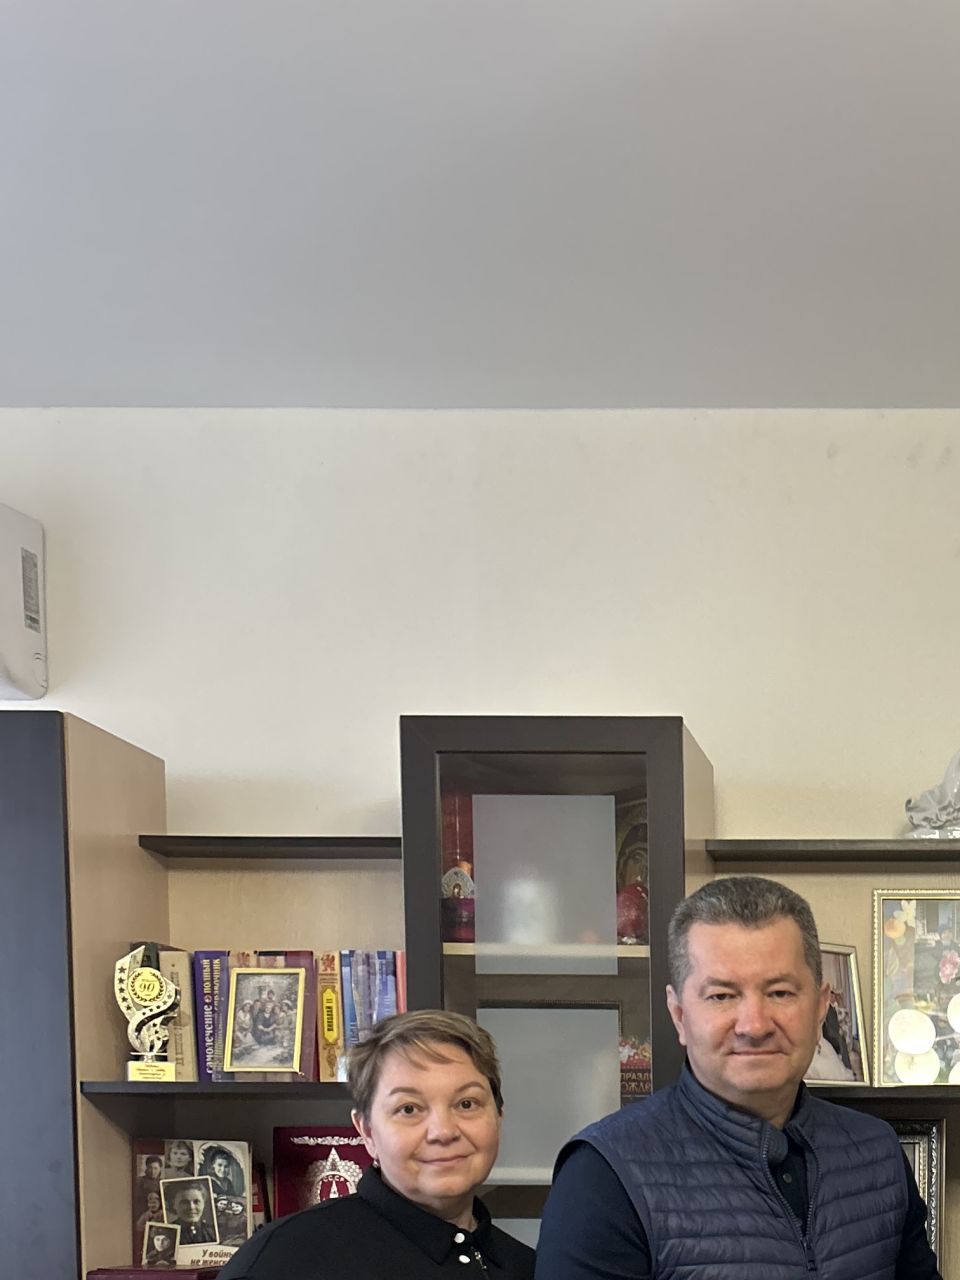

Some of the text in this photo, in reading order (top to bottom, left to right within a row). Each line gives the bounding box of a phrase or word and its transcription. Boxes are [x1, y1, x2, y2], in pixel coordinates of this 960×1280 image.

[138, 983, 156, 994] 90
[200, 958, 215, 1074] самолечение полный
[201, 1249, 209, 1258] У
[191, 1258, 201, 1266] не
